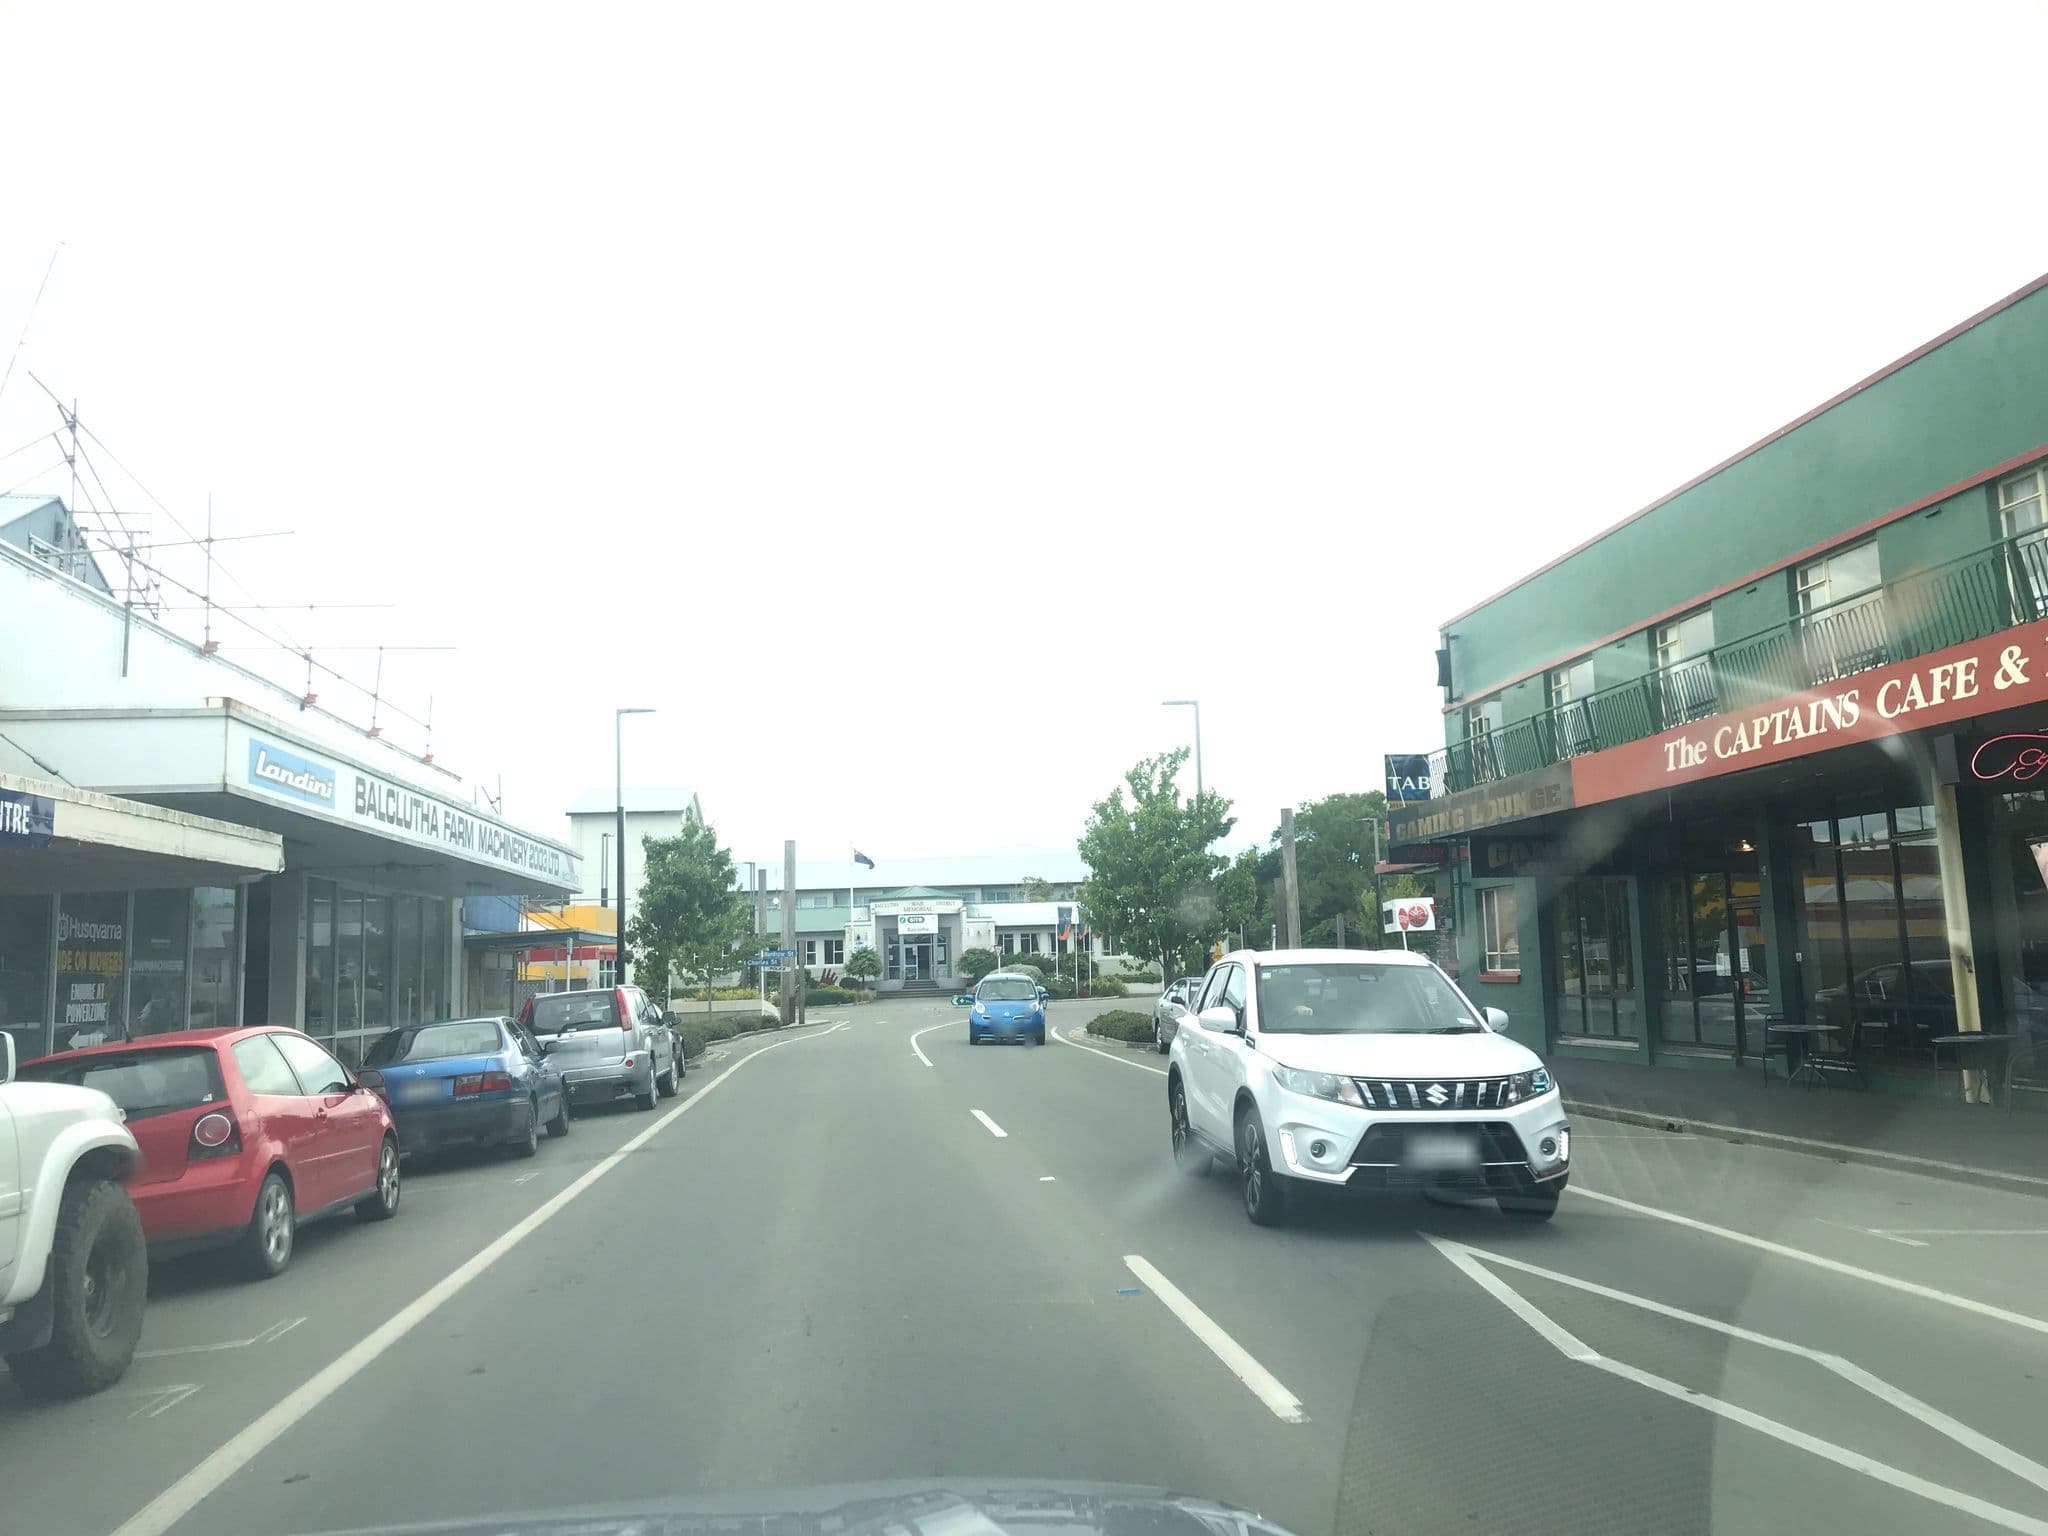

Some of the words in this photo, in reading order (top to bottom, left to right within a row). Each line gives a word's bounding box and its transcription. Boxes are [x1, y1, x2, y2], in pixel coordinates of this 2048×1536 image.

[1664, 735, 1707, 773] The
[1713, 689, 1861, 760] CAPTAINS
[1876, 656, 1979, 719] CAFE
[1993, 645, 2031, 690] &
[255, 749, 334, 799] Landini
[1387, 776, 1430, 790] TAB
[355, 776, 439, 839] BALCLUTHA
[443, 810, 474, 850] FARM
[478, 823, 529, 867] MACHINERY
[548, 849, 560, 876] LTD
[1396, 809, 1465, 841] GAMING
[1471, 783, 1561, 825] LOUNGE
[69, 917, 122, 942] Husqvarna
[96, 983, 105, 1000] AT
